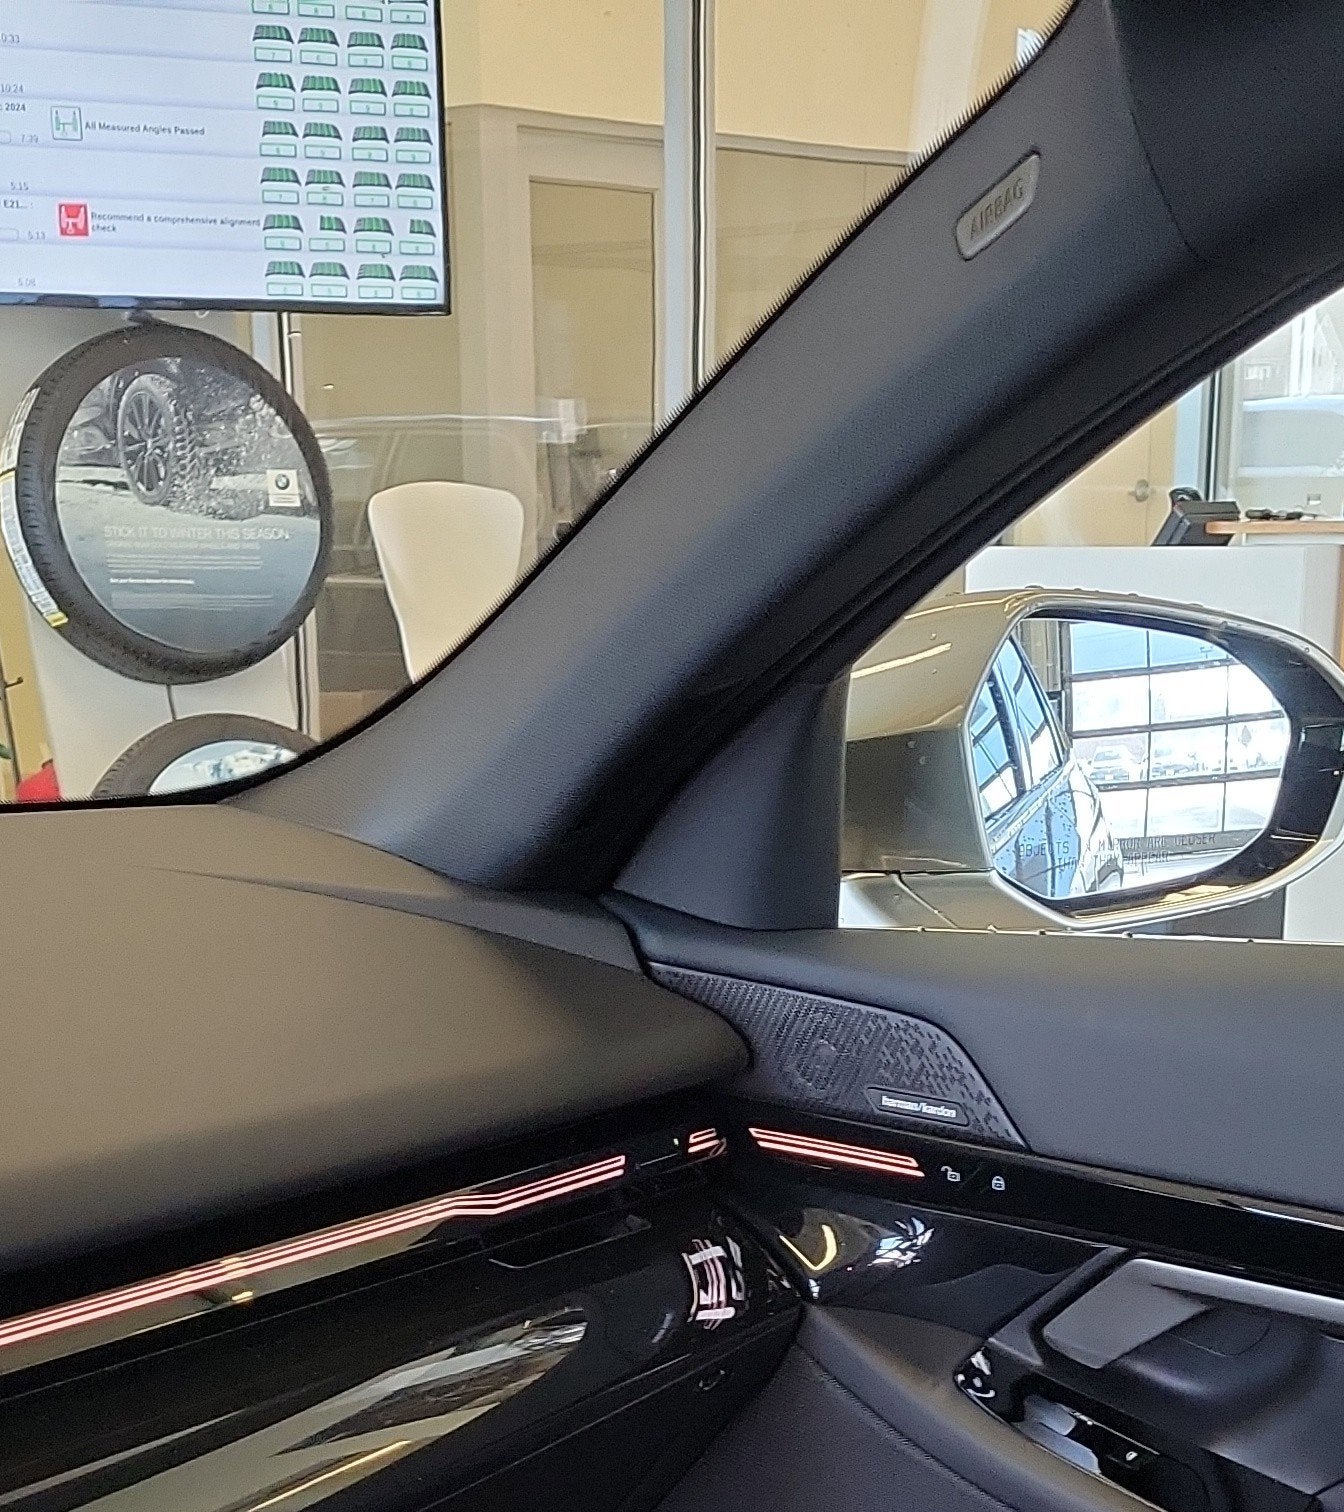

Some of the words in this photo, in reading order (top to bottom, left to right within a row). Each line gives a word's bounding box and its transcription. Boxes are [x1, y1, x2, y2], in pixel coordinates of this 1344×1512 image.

[5, 102, 26, 112] 2024
[84, 121, 96, 131] All
[98, 122, 140, 133] Measured
[142, 125, 172, 135] Angles
[174, 126, 205, 136] Passed
[969, 178, 1024, 240] AIRBAG
[91, 211, 144, 222] Recommend
[154, 216, 217, 226] comprehensive
[220, 217, 261, 228] alignment
[91, 222, 116, 232] check
